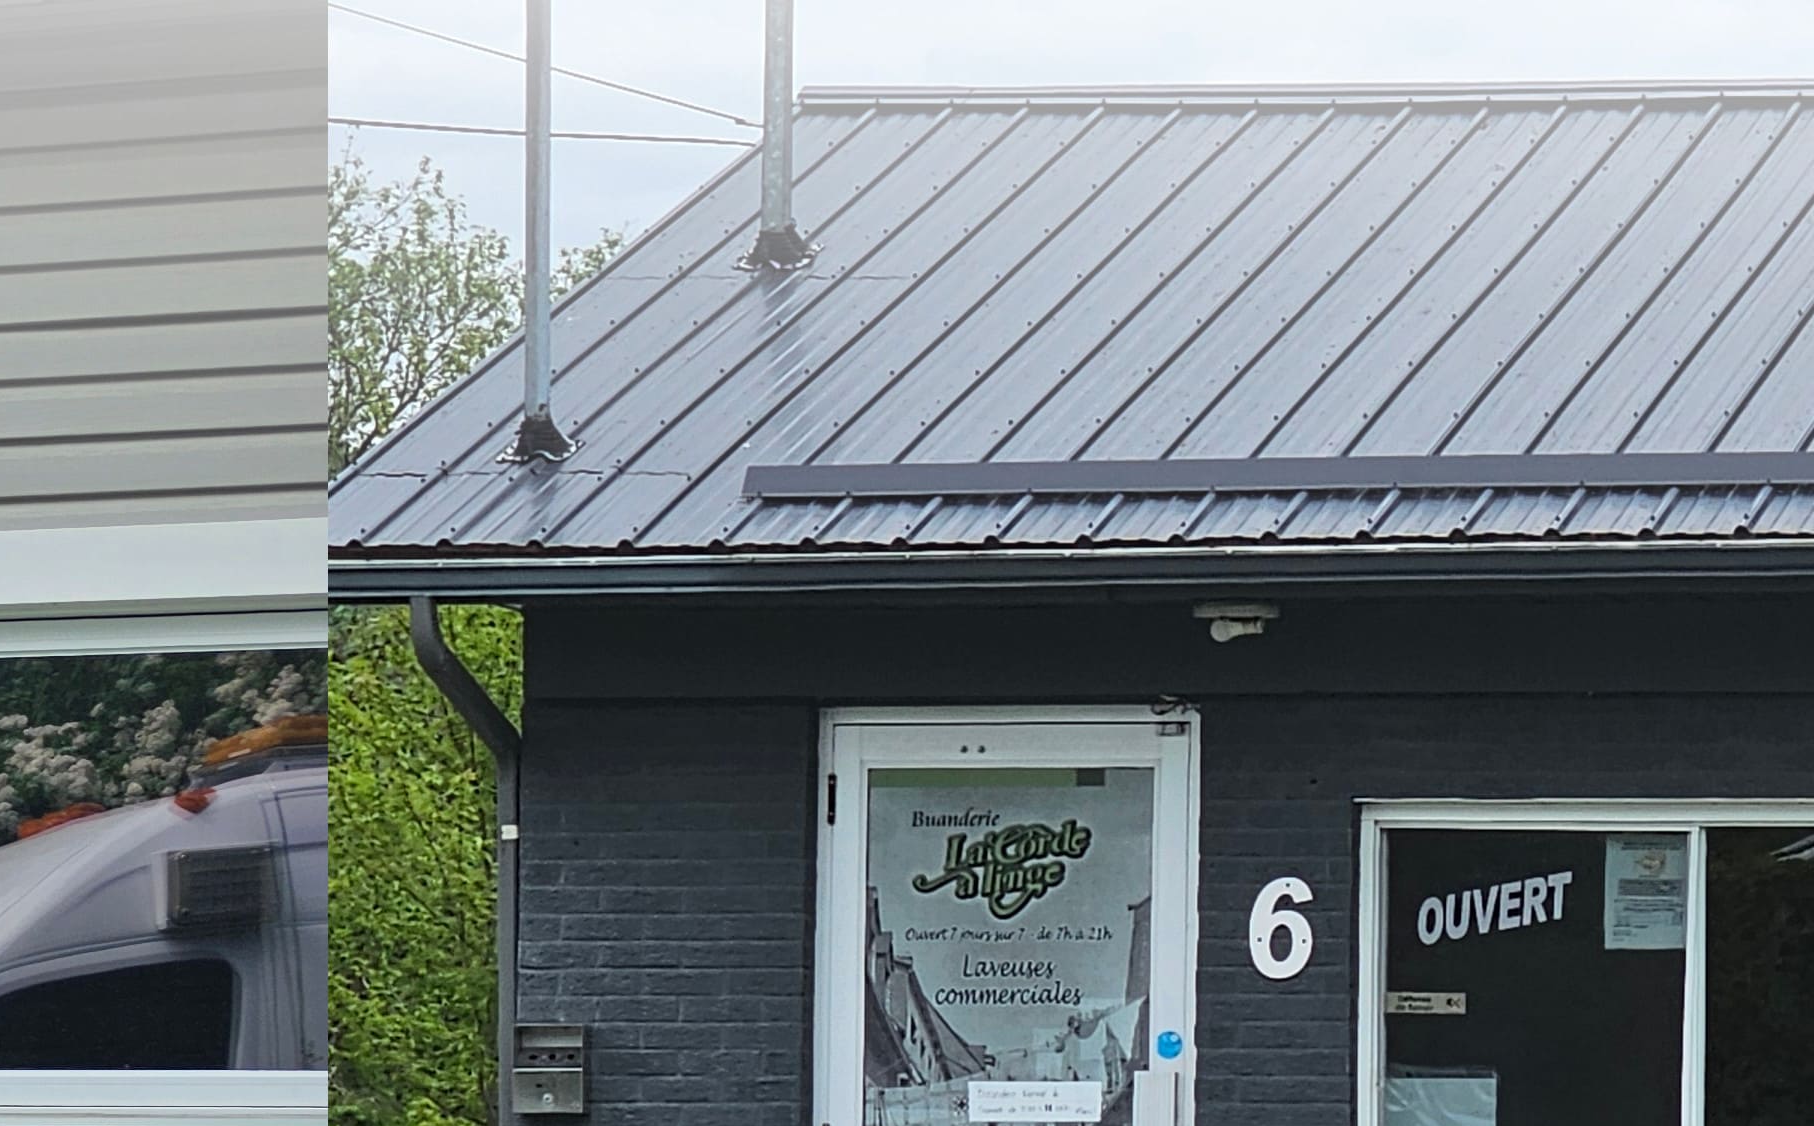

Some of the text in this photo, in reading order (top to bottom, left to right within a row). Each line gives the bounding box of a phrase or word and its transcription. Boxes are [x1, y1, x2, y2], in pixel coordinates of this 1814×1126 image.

[912, 807, 1001, 828] Buanderie
[984, 819, 1092, 865] Corde
[980, 860, 1066, 919] linge
[1417, 870, 1573, 946] OUVERT
[1249, 876, 1314, 980] 6
[962, 953, 1057, 979] Laveuses
[935, 980, 1084, 1007] commerciales
